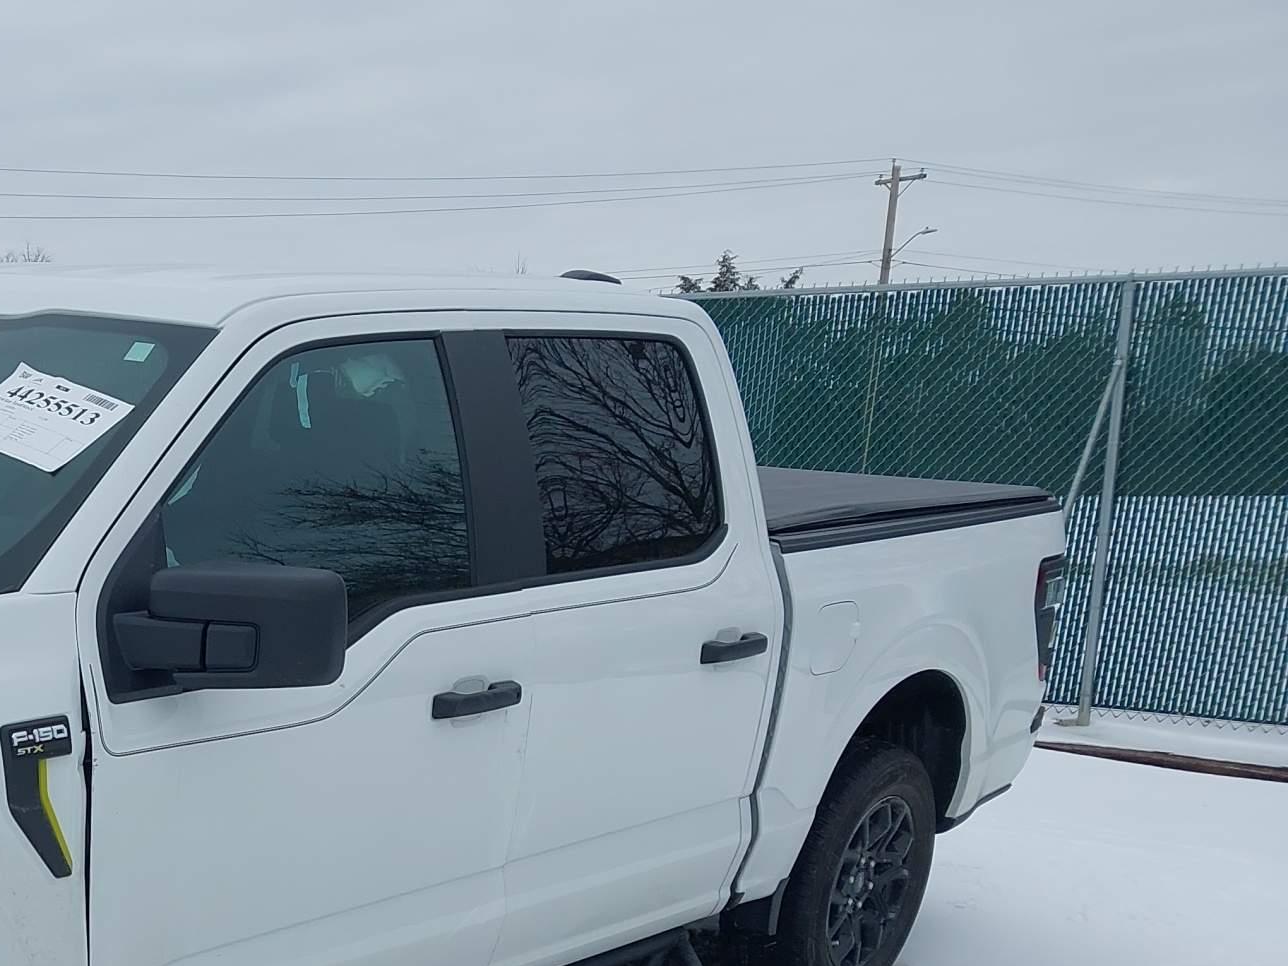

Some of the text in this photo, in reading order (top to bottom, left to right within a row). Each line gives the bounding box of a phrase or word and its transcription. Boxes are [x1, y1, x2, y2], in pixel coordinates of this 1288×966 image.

[7, 384, 101, 426] 44255513
[12, 724, 68, 747] F-150
[17, 744, 44, 756] STX
